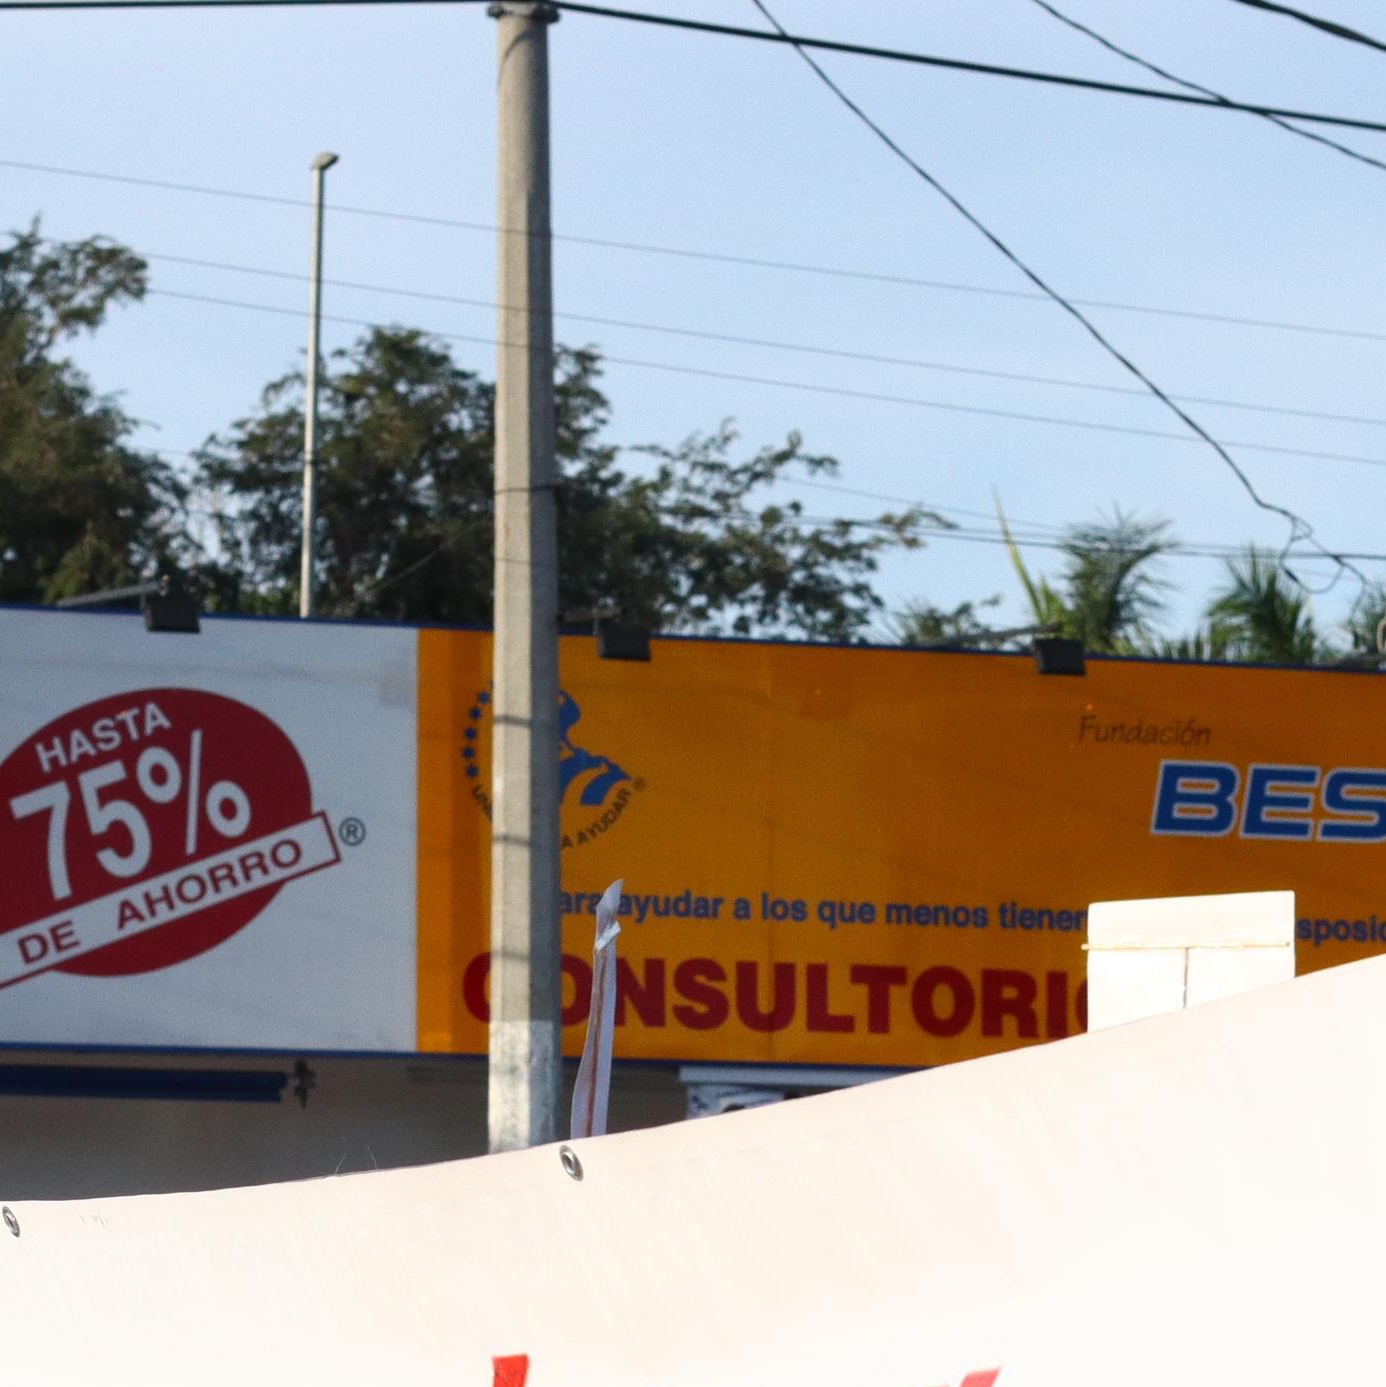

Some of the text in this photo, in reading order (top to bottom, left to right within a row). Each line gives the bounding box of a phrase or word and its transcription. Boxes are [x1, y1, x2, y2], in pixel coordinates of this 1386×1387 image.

[35, 702, 172, 773] HASTA
[1078, 713, 1211, 747] Fundación
[9, 728, 252, 901] 75%
[17, 837, 303, 965] DE AHORRO
[560, 891, 599, 915] ara
[617, 889, 721, 925] ayudar
[732, 902, 751, 921] a
[760, 892, 808, 922] los
[818, 902, 877, 930] que
[885, 902, 988, 930] menos
